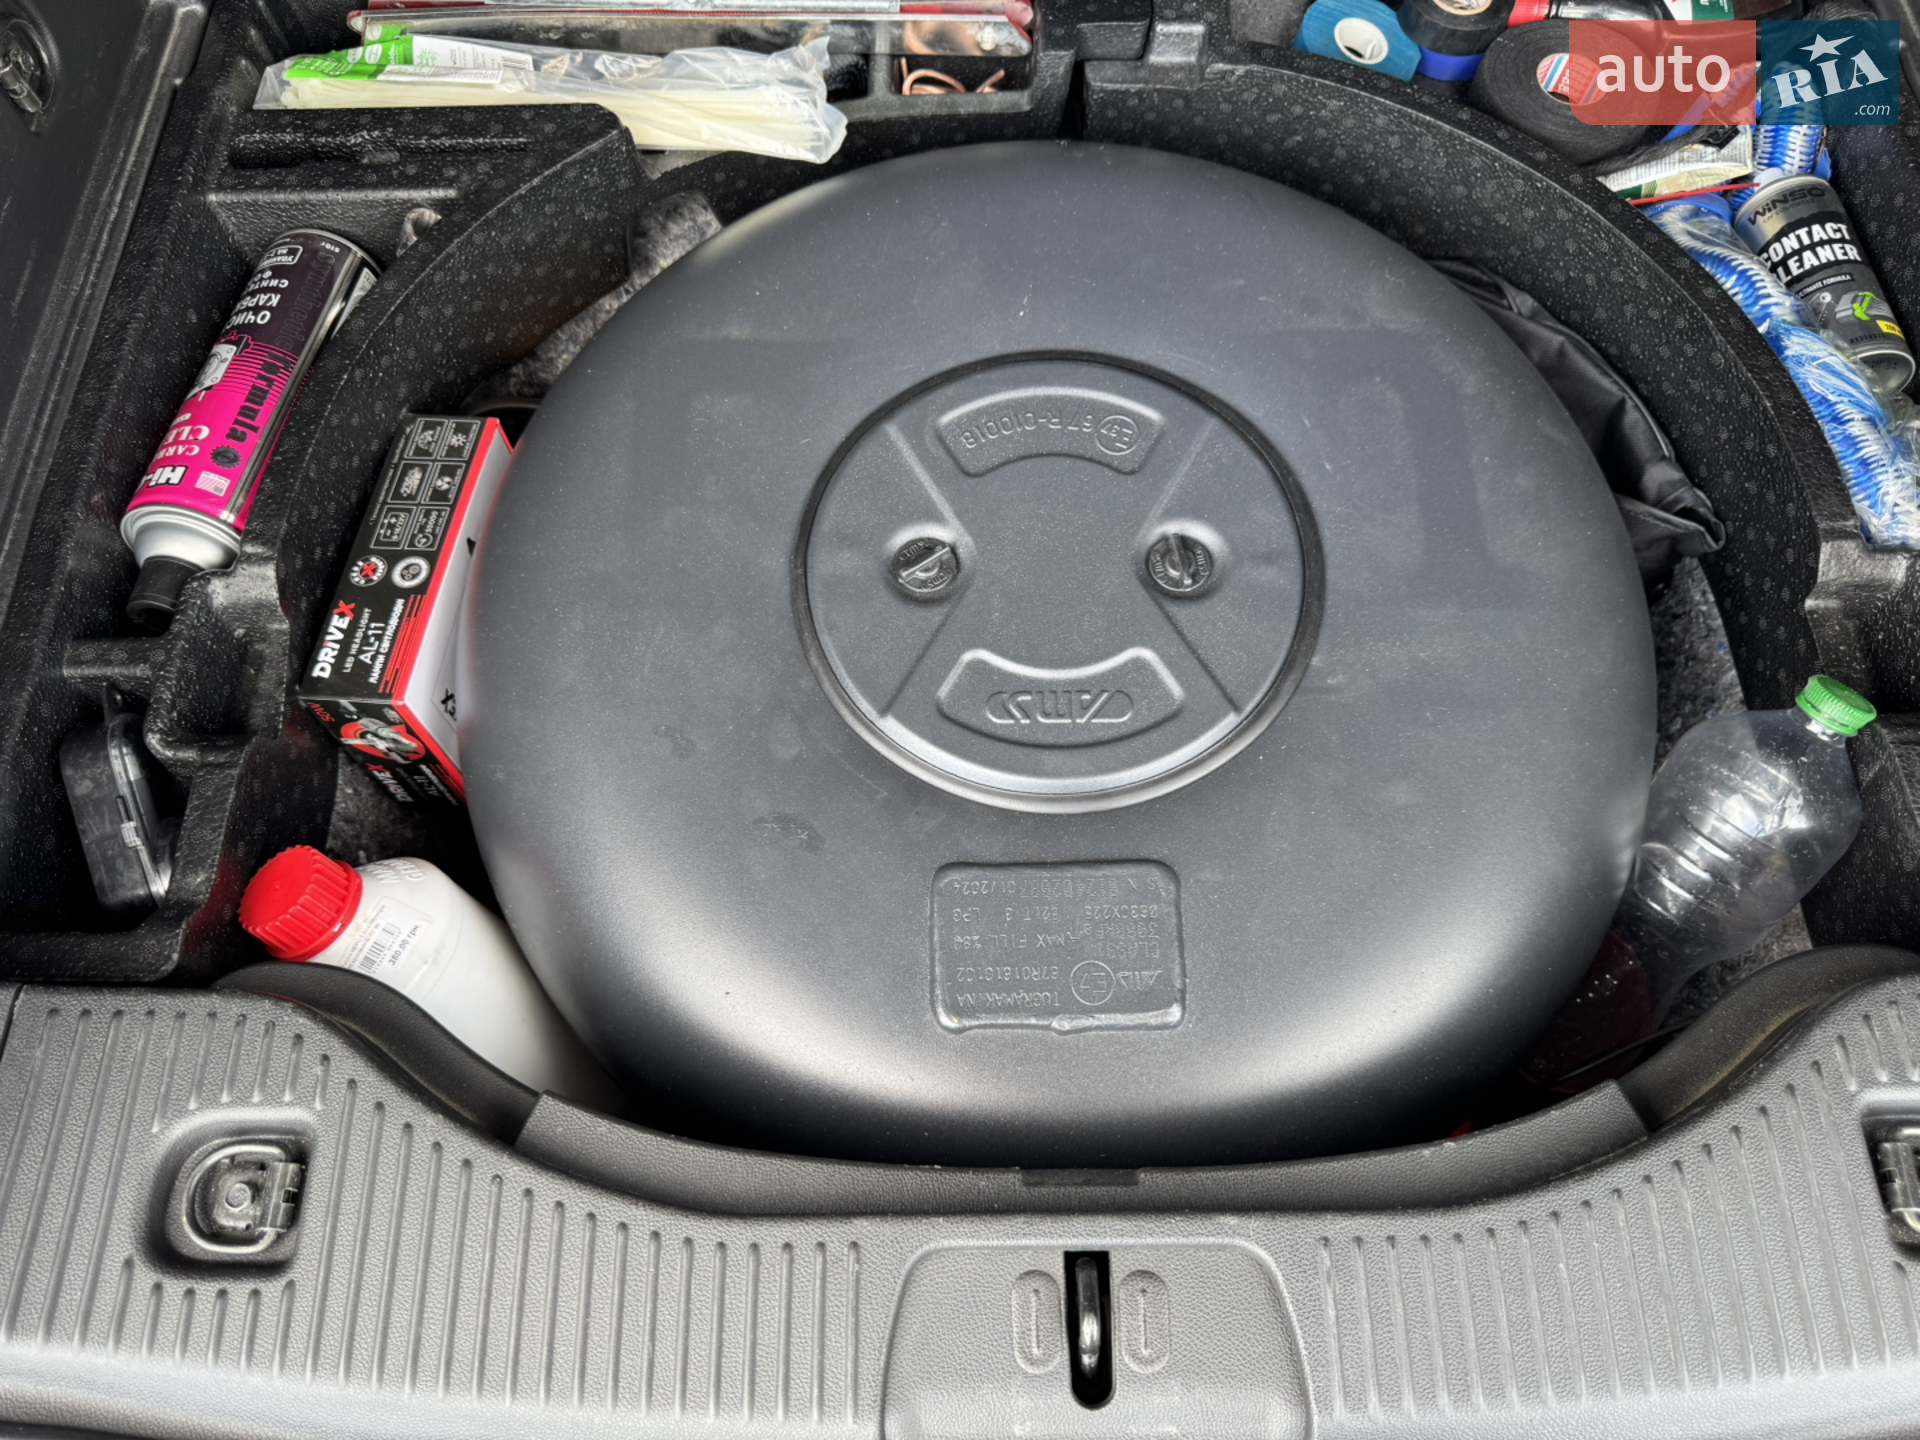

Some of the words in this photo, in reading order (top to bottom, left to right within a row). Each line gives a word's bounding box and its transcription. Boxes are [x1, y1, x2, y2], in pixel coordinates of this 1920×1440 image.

[1759, 222, 1850, 268] CONTACT
[1776, 244, 1862, 284] LEANER
[226, 351, 292, 443] formula
[350, 608, 372, 658] HEADLIGHT
[359, 622, 385, 664] AL-11
[1036, 934, 1065, 948] MAX
